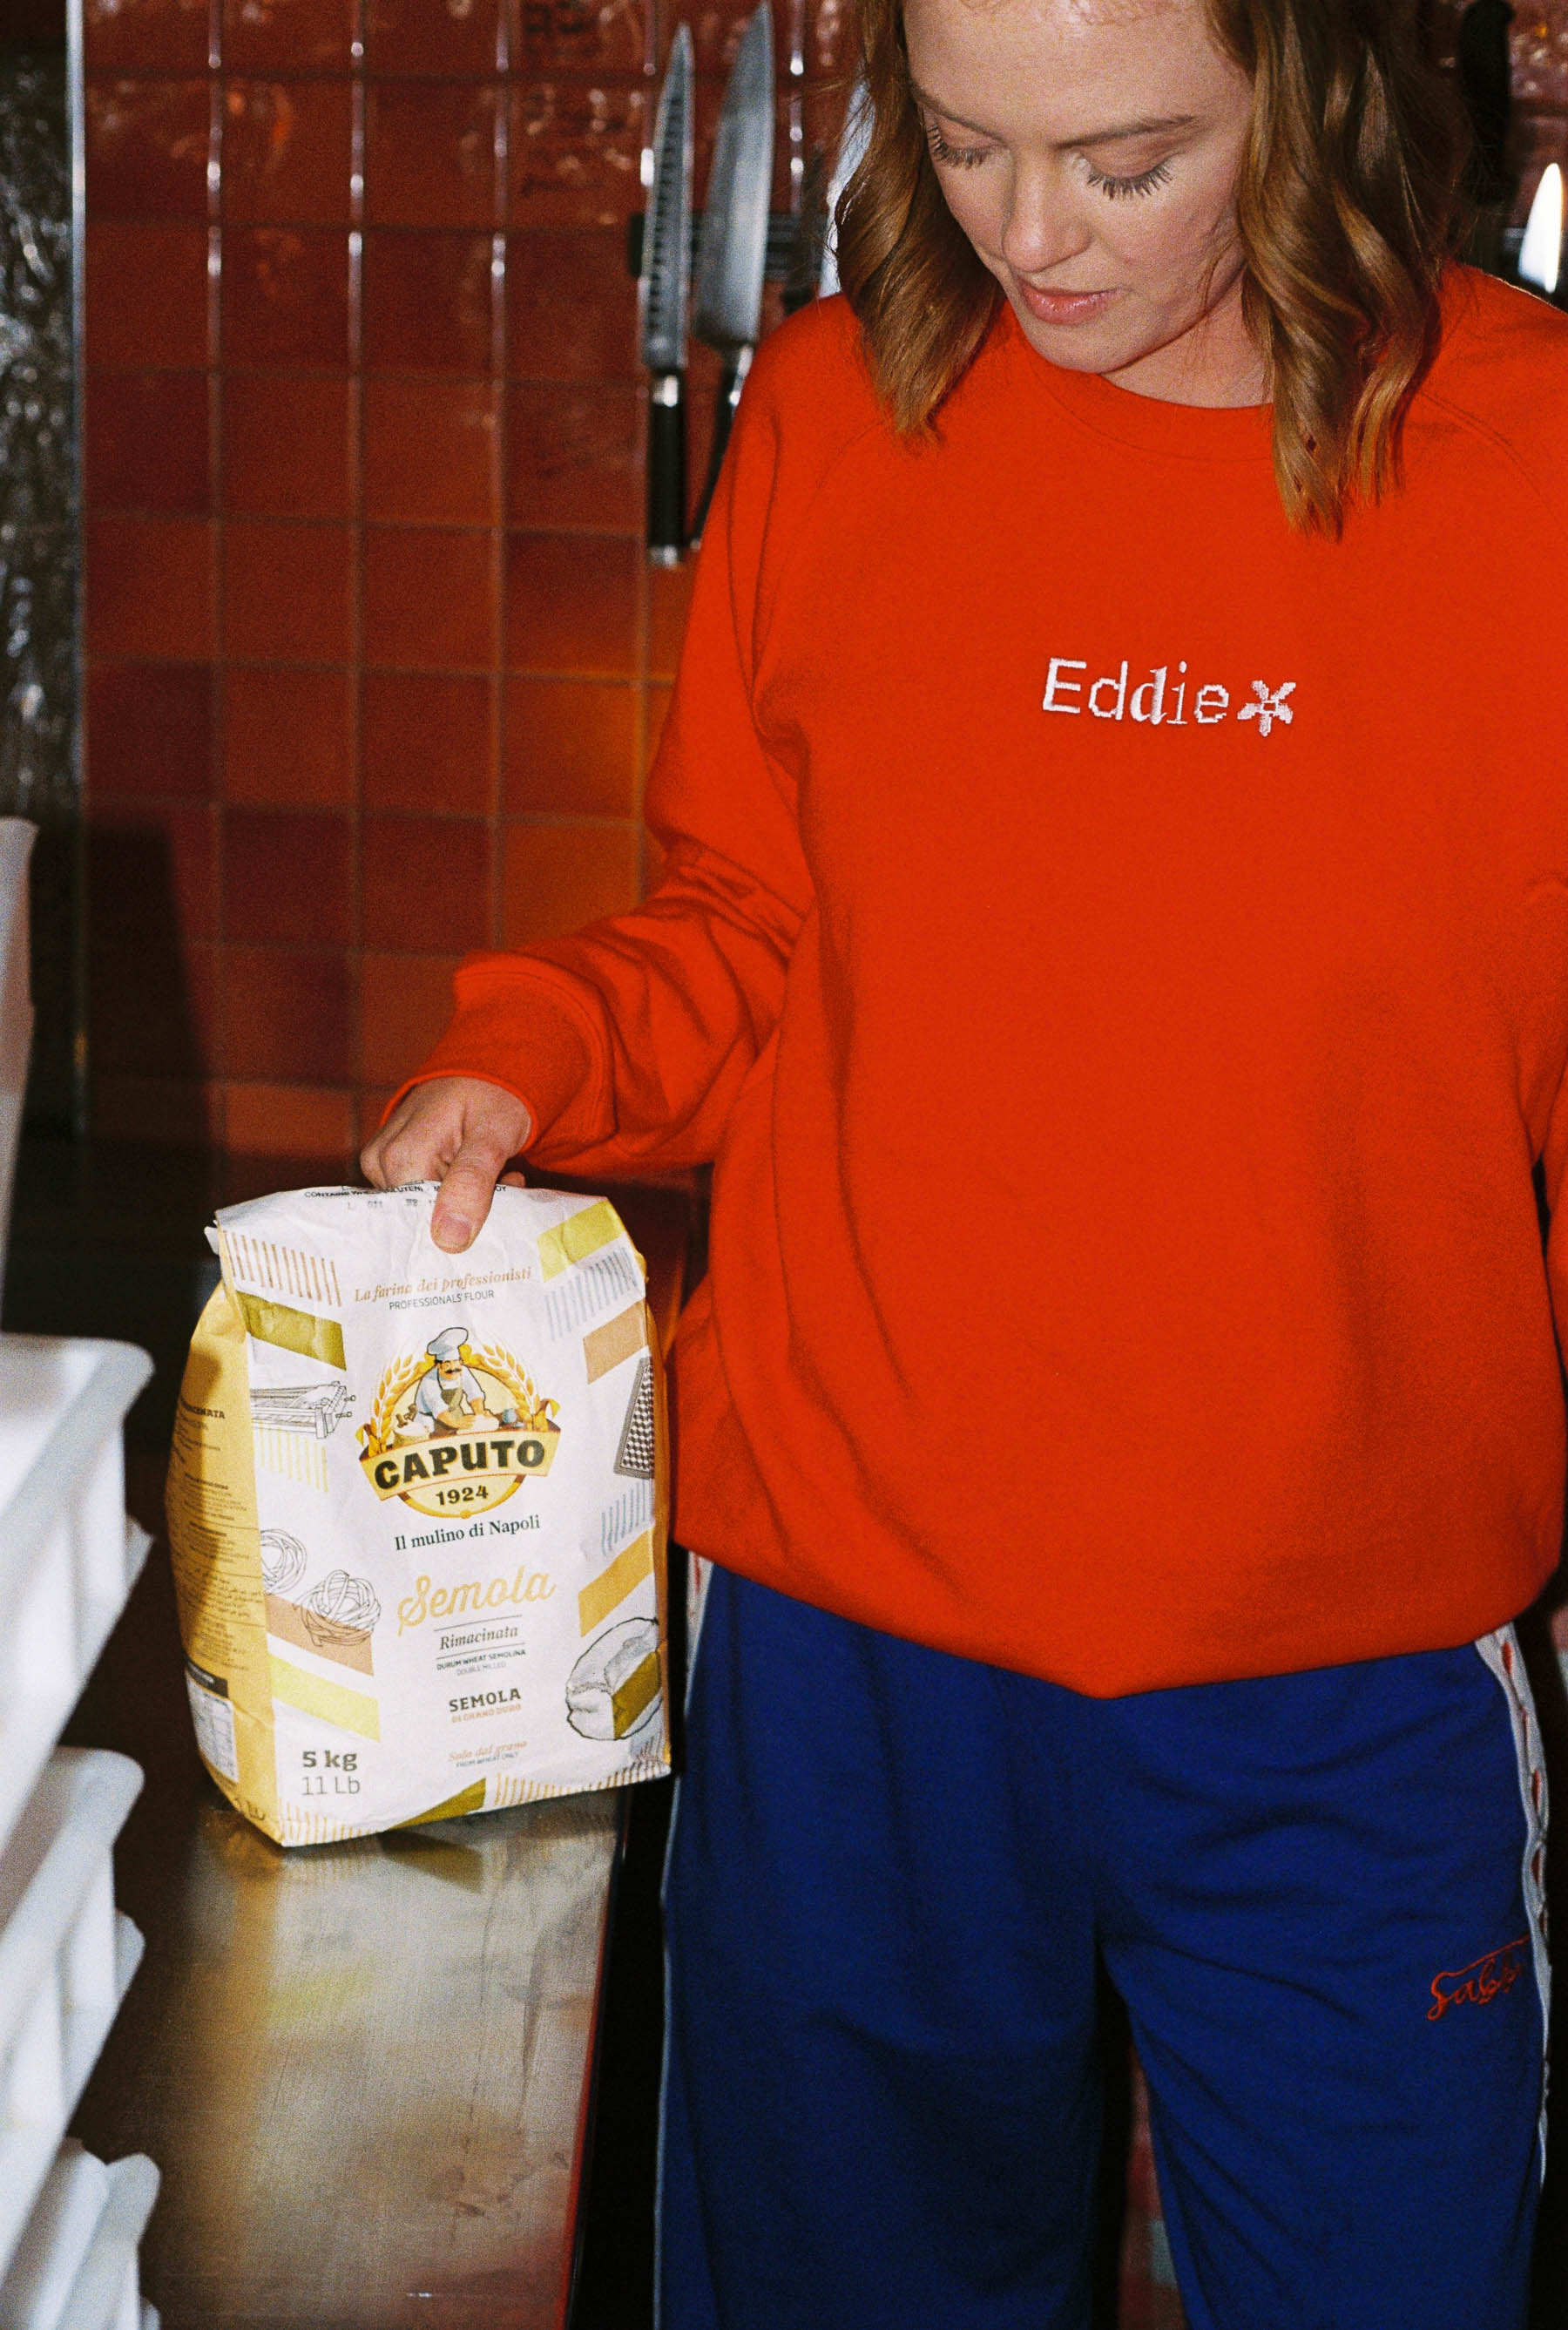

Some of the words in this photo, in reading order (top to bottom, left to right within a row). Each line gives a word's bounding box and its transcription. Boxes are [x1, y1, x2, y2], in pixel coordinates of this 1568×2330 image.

[1043, 658, 1229, 725] Eddie
[355, 1289, 371, 1302] La
[416, 1278, 438, 1292] dei
[441, 1266, 531, 1293] professionisti
[463, 1290, 495, 1302] FLOUR
[375, 1439, 545, 1490] CAPUTO
[436, 1485, 489, 1506] 1924
[395, 1536, 407, 1551] Il
[411, 1529, 465, 1548] mulino
[469, 1522, 484, 1538] di
[489, 1514, 540, 1537] Napoli
[397, 1565, 557, 1637] Semola
[439, 1626, 519, 1650] Rimacinata
[436, 1659, 463, 1671] DURUM
[463, 1655, 487, 1665] WHEAT
[449, 1688, 522, 1713] SEMOLA
[302, 1751, 316, 1768] 5
[325, 1750, 358, 1771] kg
[301, 1777, 328, 1796] 11
[335, 1774, 361, 1794] Lb
